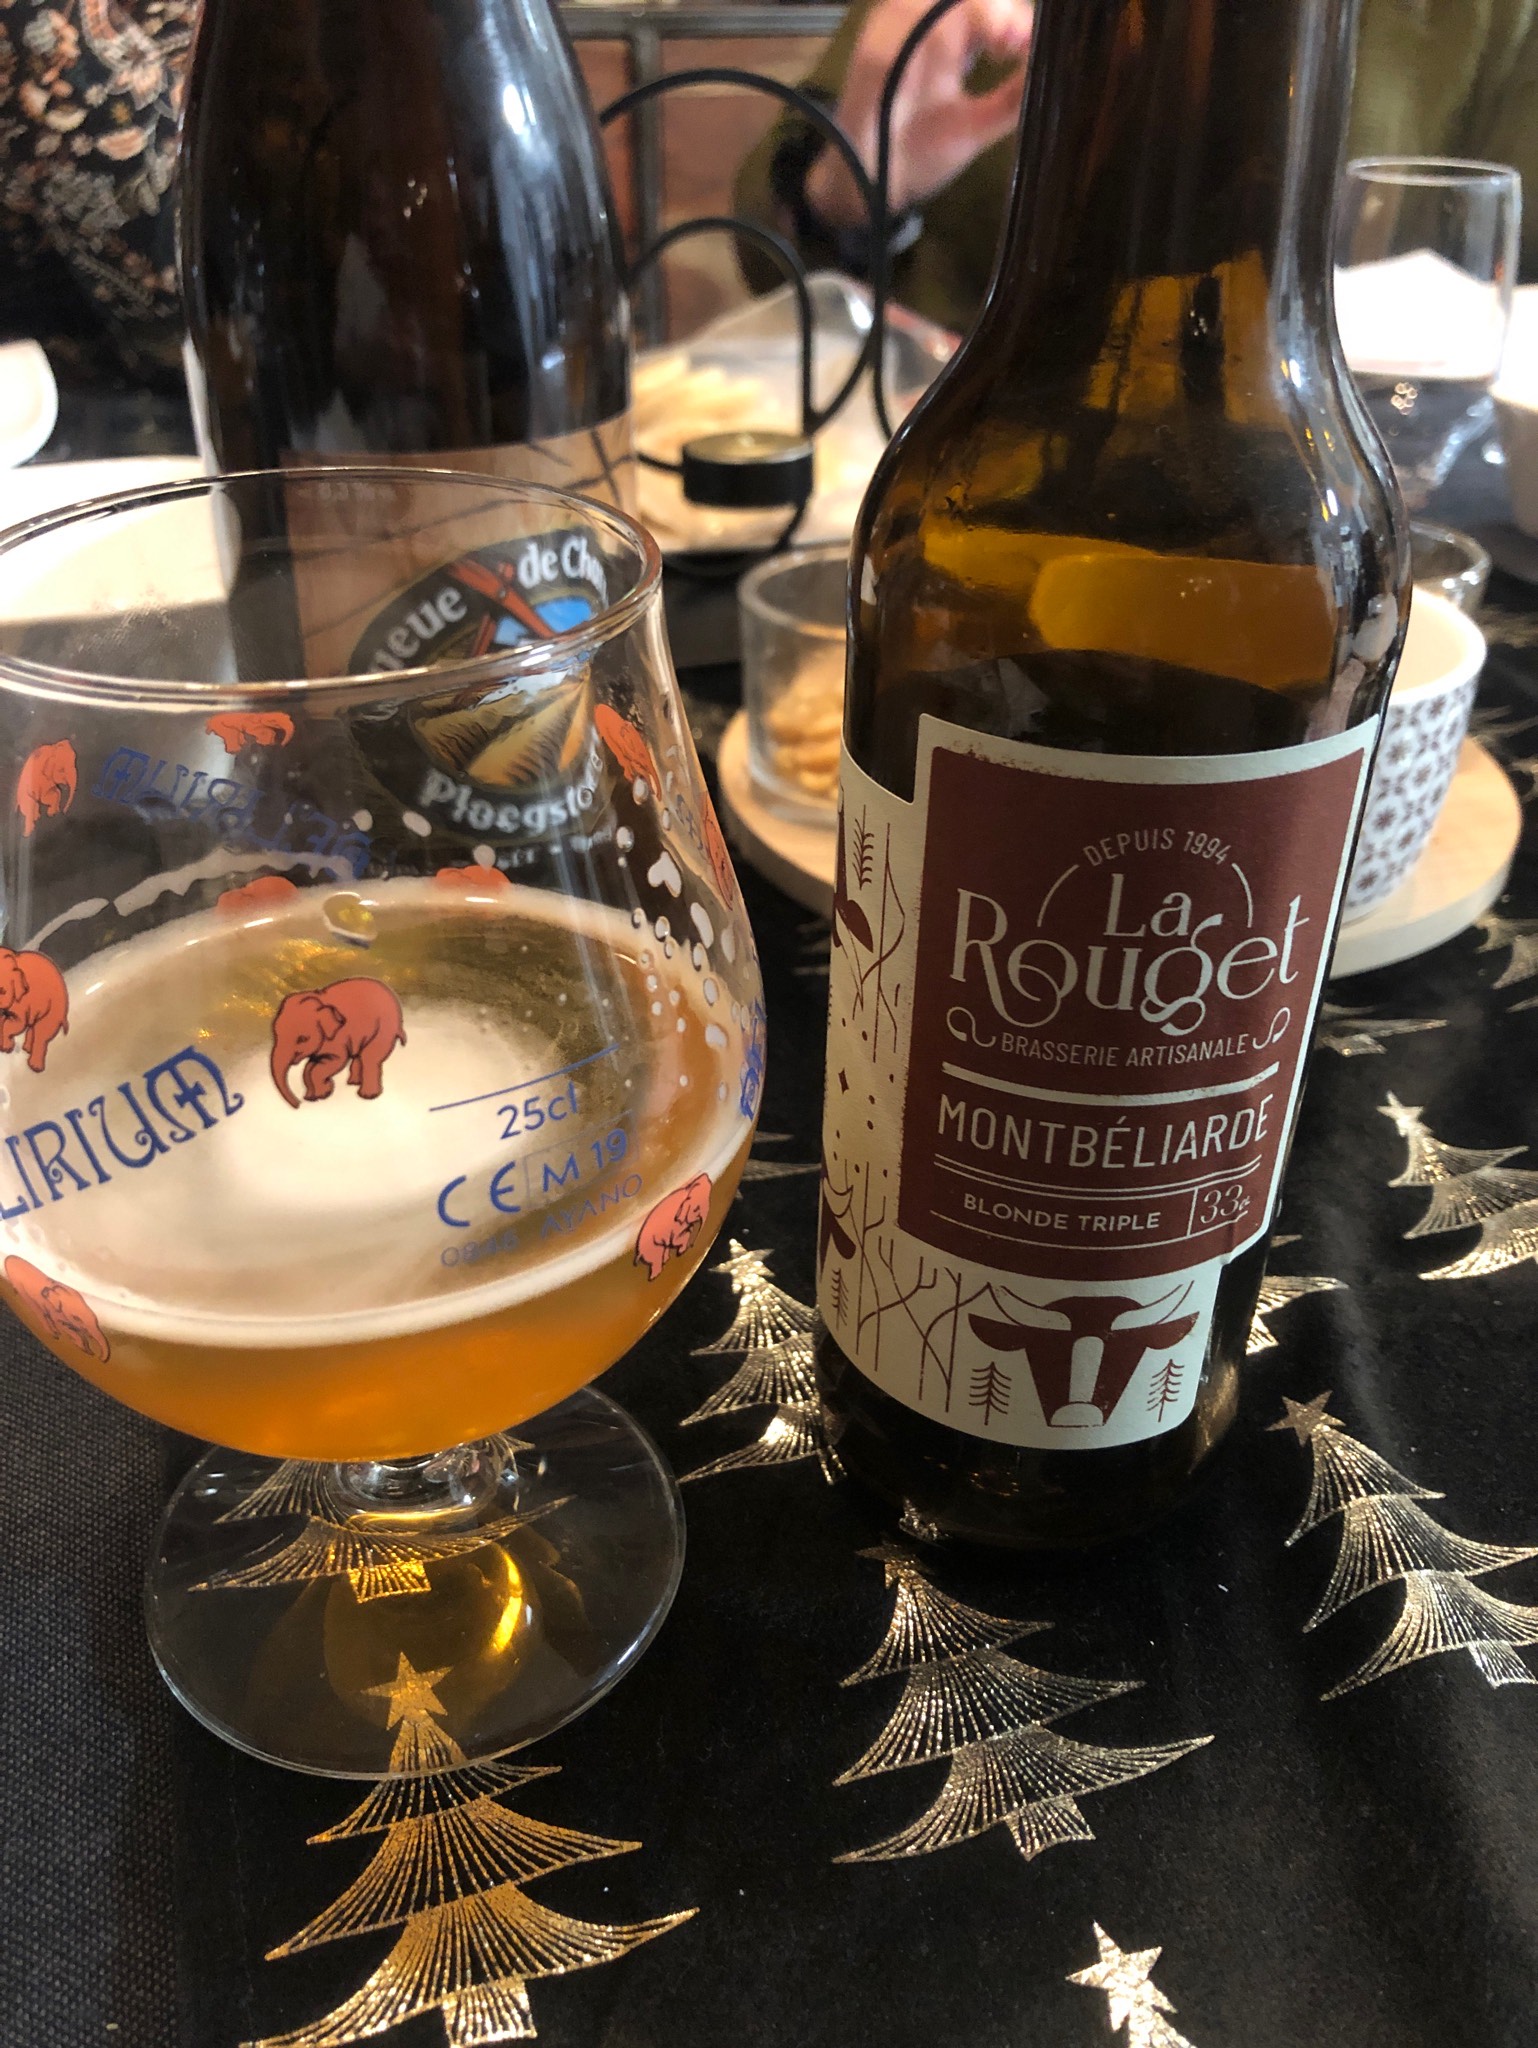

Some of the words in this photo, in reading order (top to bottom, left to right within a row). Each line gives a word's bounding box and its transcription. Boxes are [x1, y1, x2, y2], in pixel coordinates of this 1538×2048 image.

[516, 541, 559, 590] de
[1083, 827, 1176, 867] DEPUIS
[1183, 829, 1232, 865] 1994
[1103, 872, 1192, 938] La
[949, 887, 1310, 1036] Rouget
[1000, 1031, 1119, 1067] BRASSERIE
[1125, 1033, 1250, 1067] ARTISANALE
[497, 1080, 578, 1140] 25cl
[937, 1093, 1274, 1169] MONTBÉLIARDE
[541, 1153, 580, 1193] M
[591, 1127, 629, 1170] 19
[540, 1173, 644, 1238] AYANO
[963, 1193, 1069, 1231] BLONDE
[1078, 1211, 1162, 1233] TRIPLE
